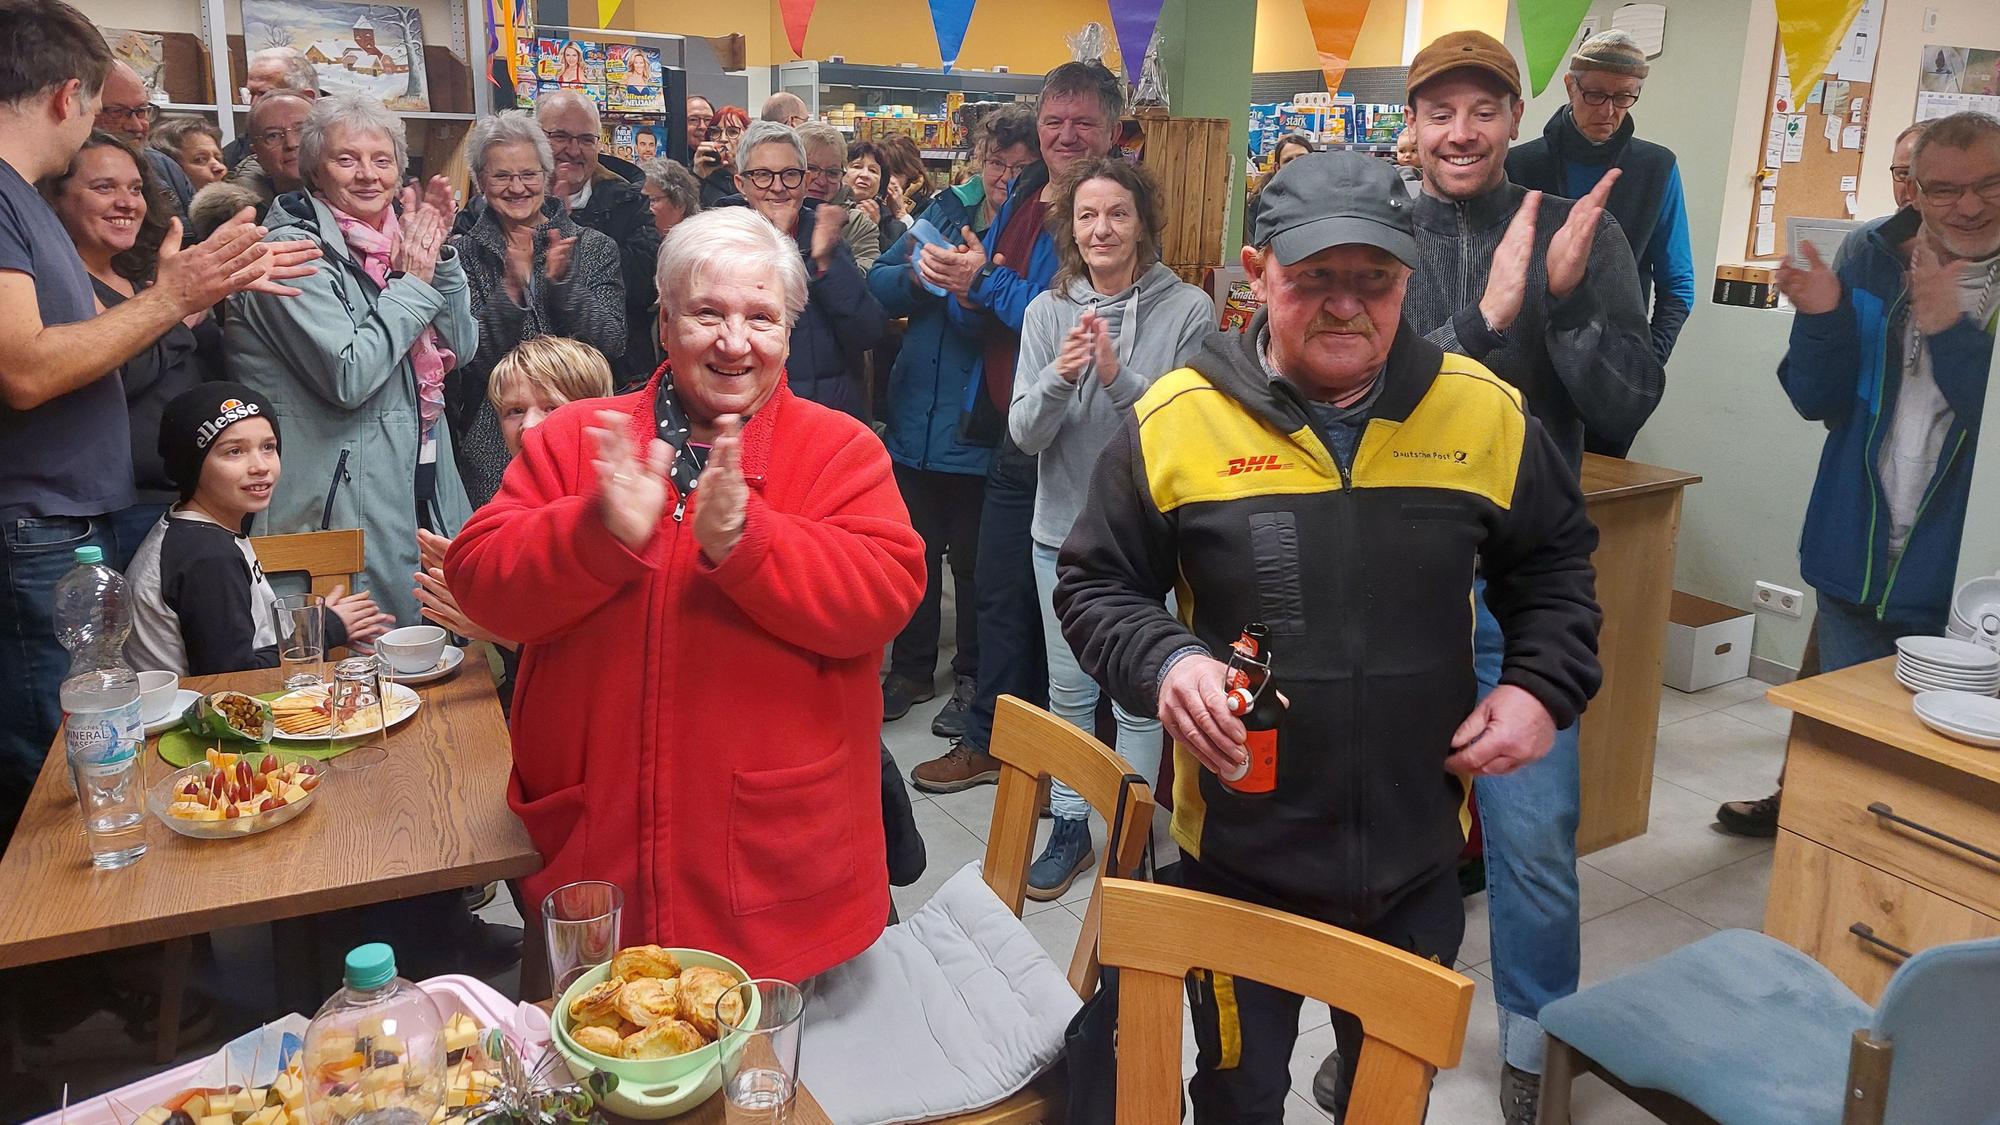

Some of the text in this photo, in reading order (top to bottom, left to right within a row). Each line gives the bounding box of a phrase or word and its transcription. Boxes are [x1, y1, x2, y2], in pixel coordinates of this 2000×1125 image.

[539, 40, 561, 56] TV
[1285, 115, 1307, 127] stark
[196, 402, 260, 449] ellesse
[1393, 450, 1450, 460] Deutsche Post
[1227, 455, 1282, 476] DHL
